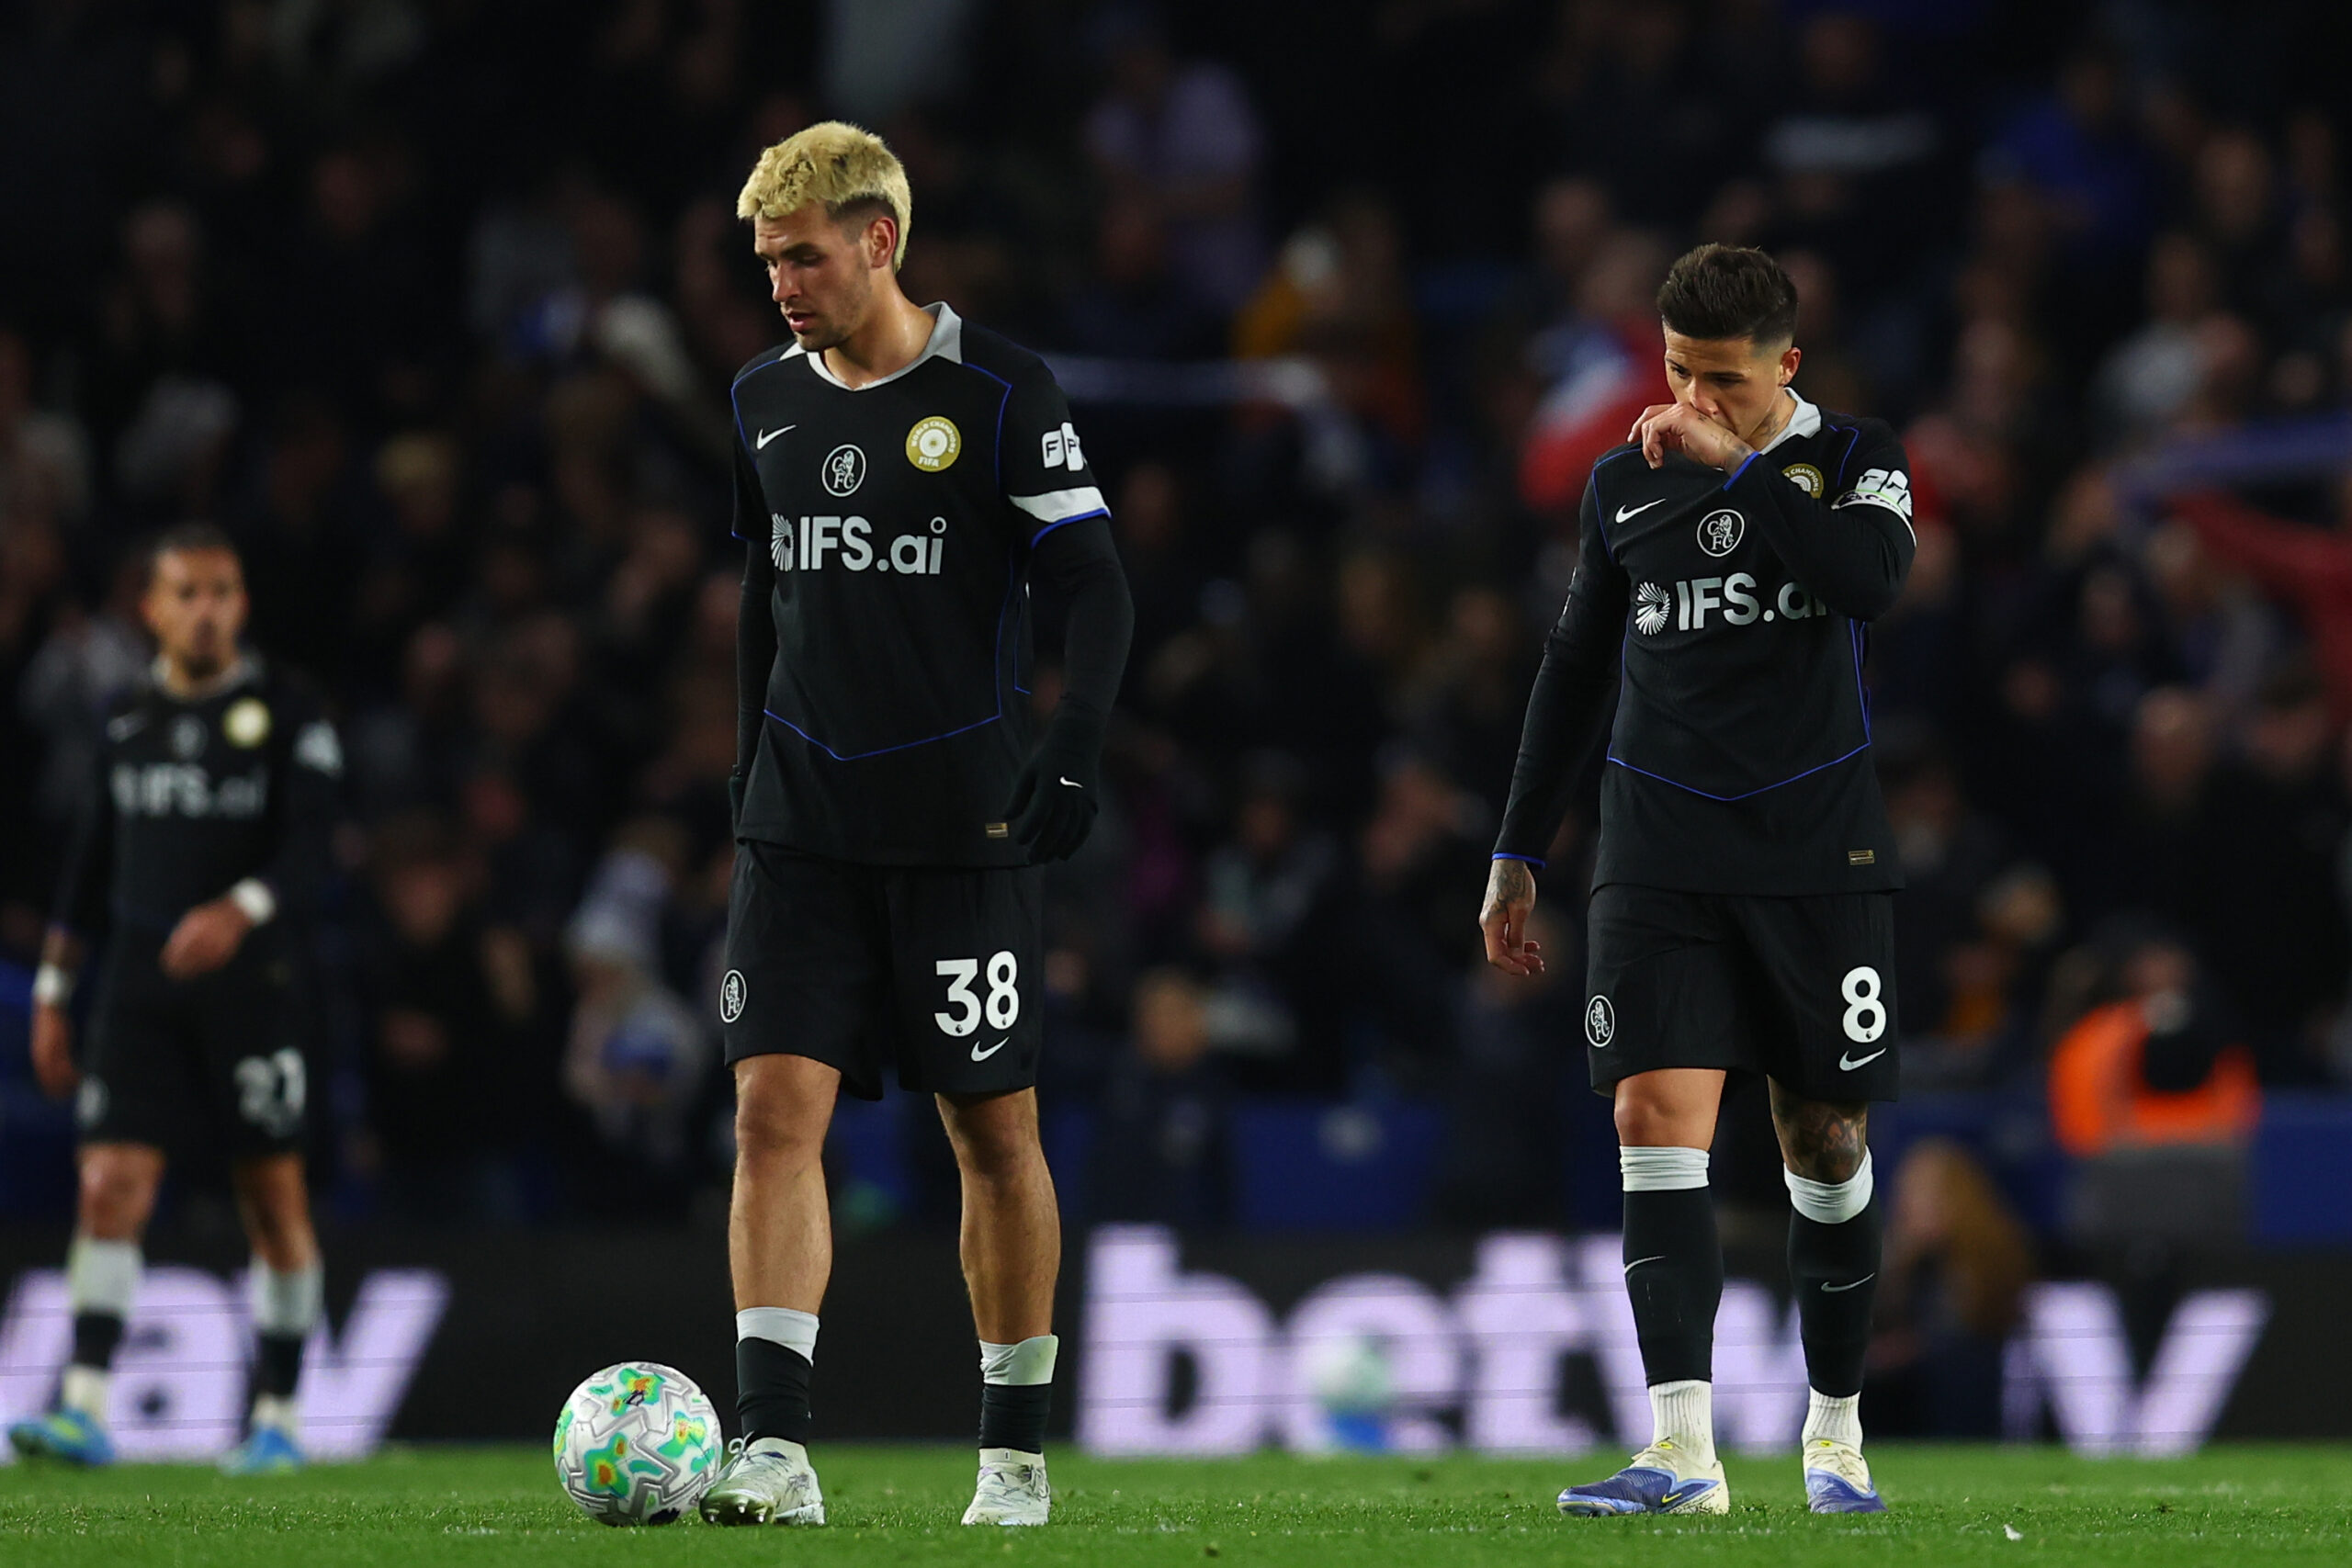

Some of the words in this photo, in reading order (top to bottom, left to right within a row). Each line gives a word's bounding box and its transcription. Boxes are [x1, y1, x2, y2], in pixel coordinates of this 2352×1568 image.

[910, 423, 929, 447] WORLD
[929, 420, 957, 453] CHAMPIONS
[918, 456, 940, 468] FIFA
[799, 515, 946, 575] IFS.ai
[933, 950, 1021, 1038] 38
[1840, 965, 1888, 1043] 8
